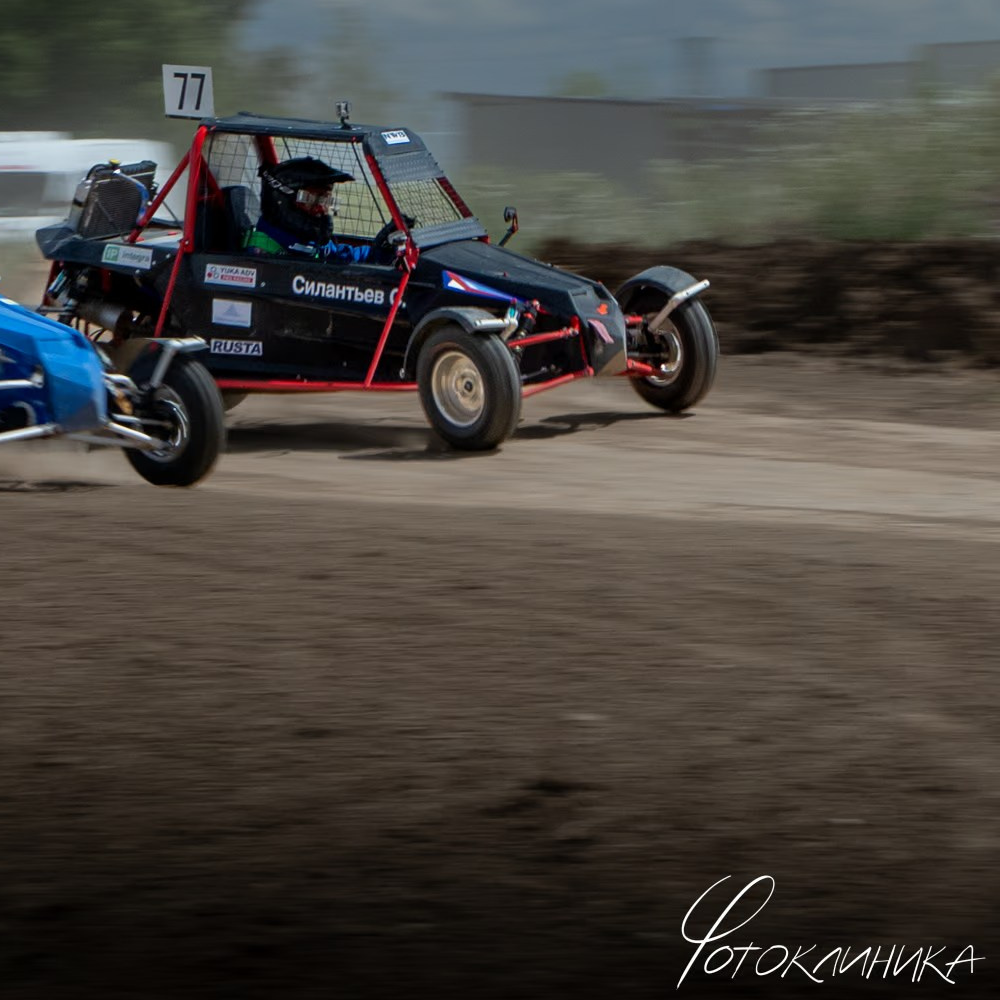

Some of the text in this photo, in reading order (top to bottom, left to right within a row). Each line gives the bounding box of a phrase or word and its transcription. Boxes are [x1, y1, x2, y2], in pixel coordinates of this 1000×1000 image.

[173, 72, 206, 110] 77
[292, 275, 385, 305] Силантьев
[212, 340, 261, 354] RUSTA
